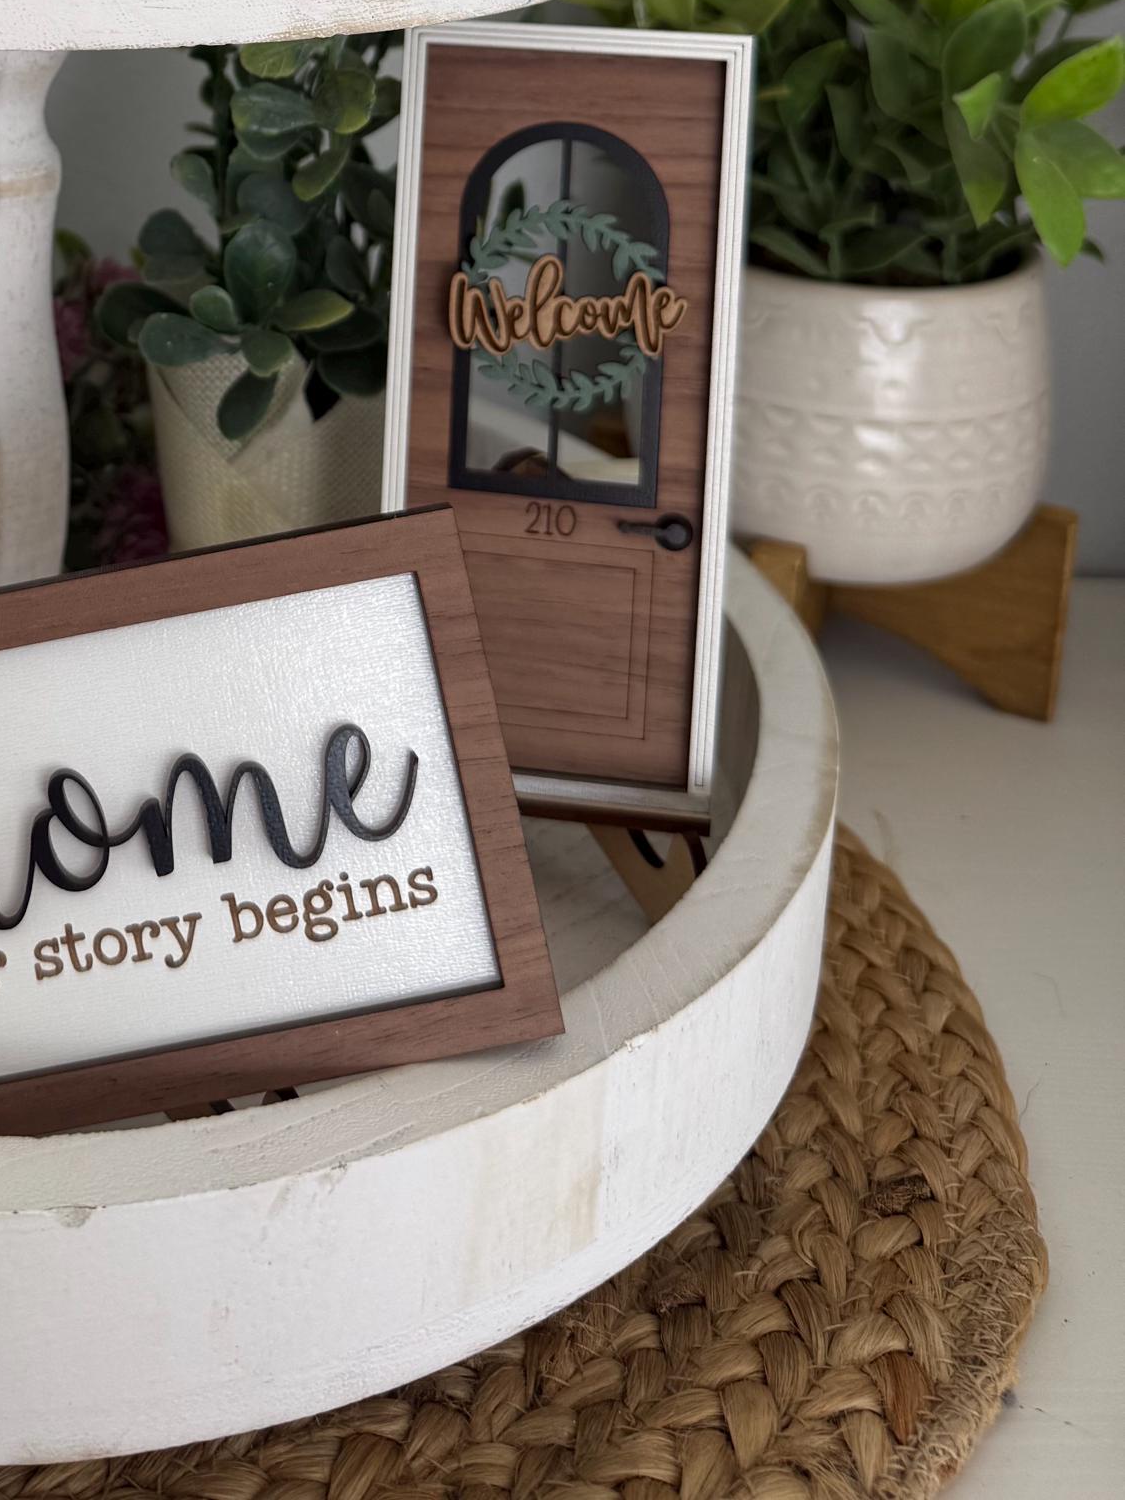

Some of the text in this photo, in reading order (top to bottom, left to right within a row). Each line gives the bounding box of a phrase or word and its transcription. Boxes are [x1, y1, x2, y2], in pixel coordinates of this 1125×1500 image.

[450, 255, 687, 356] Welcome
[524, 501, 577, 536] 210
[33, 922, 202, 981] story
[220, 865, 439, 943] begins
